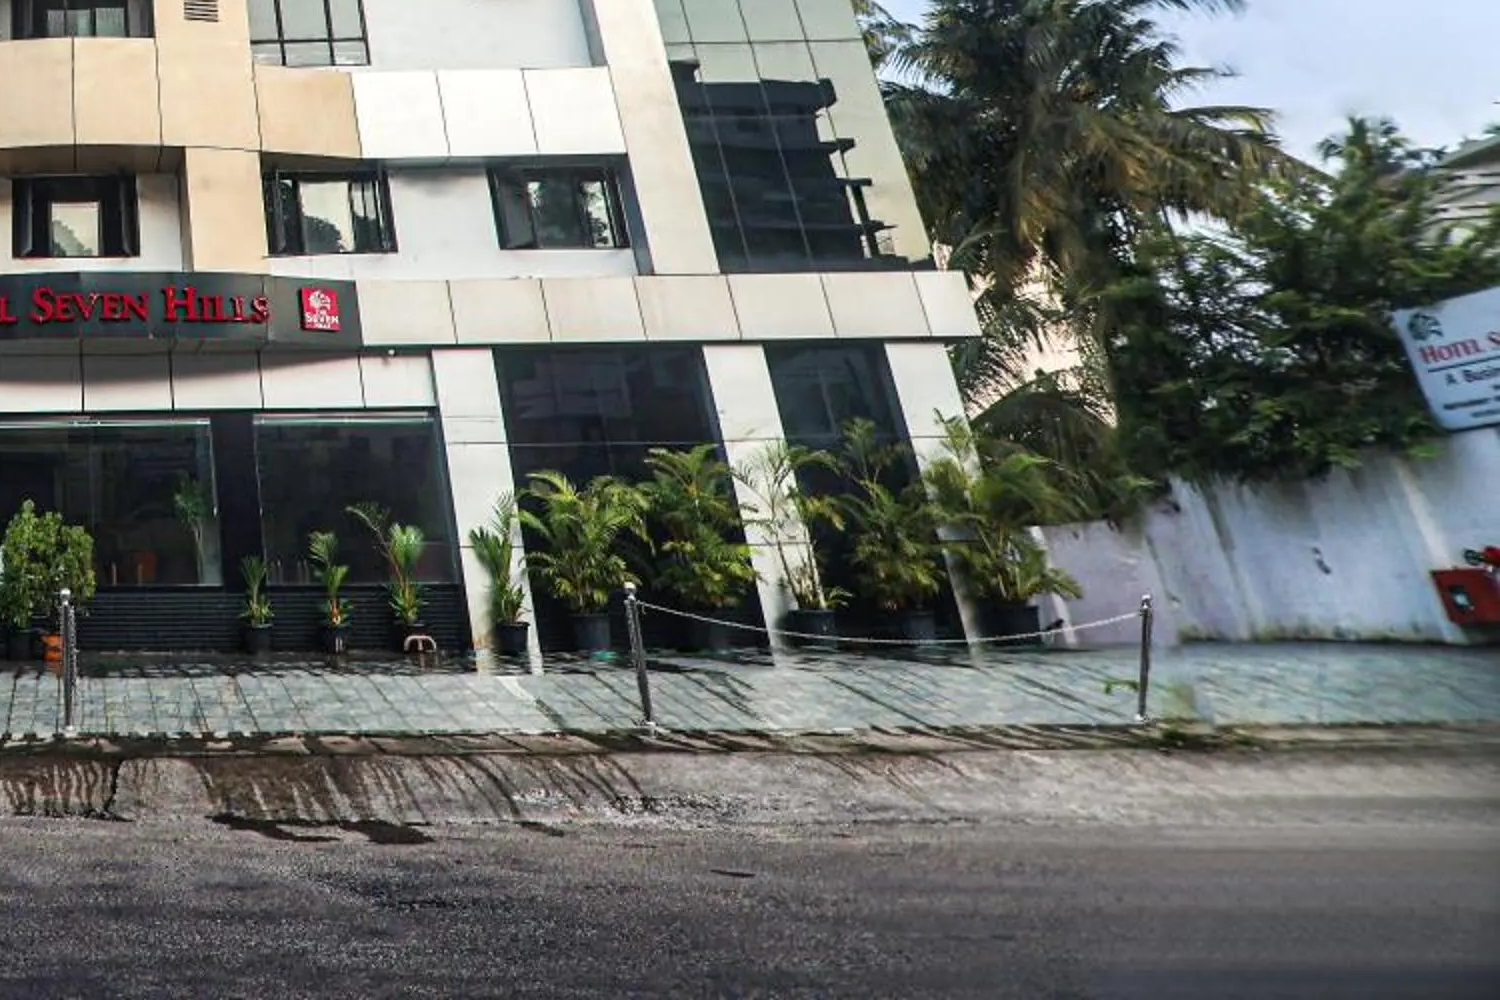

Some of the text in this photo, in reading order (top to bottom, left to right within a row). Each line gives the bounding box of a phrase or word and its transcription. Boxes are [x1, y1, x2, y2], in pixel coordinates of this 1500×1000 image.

[29, 286, 149, 324] SEVEN
[161, 285, 271, 324] HILLS
[1419, 339, 1484, 364] HOTEL
